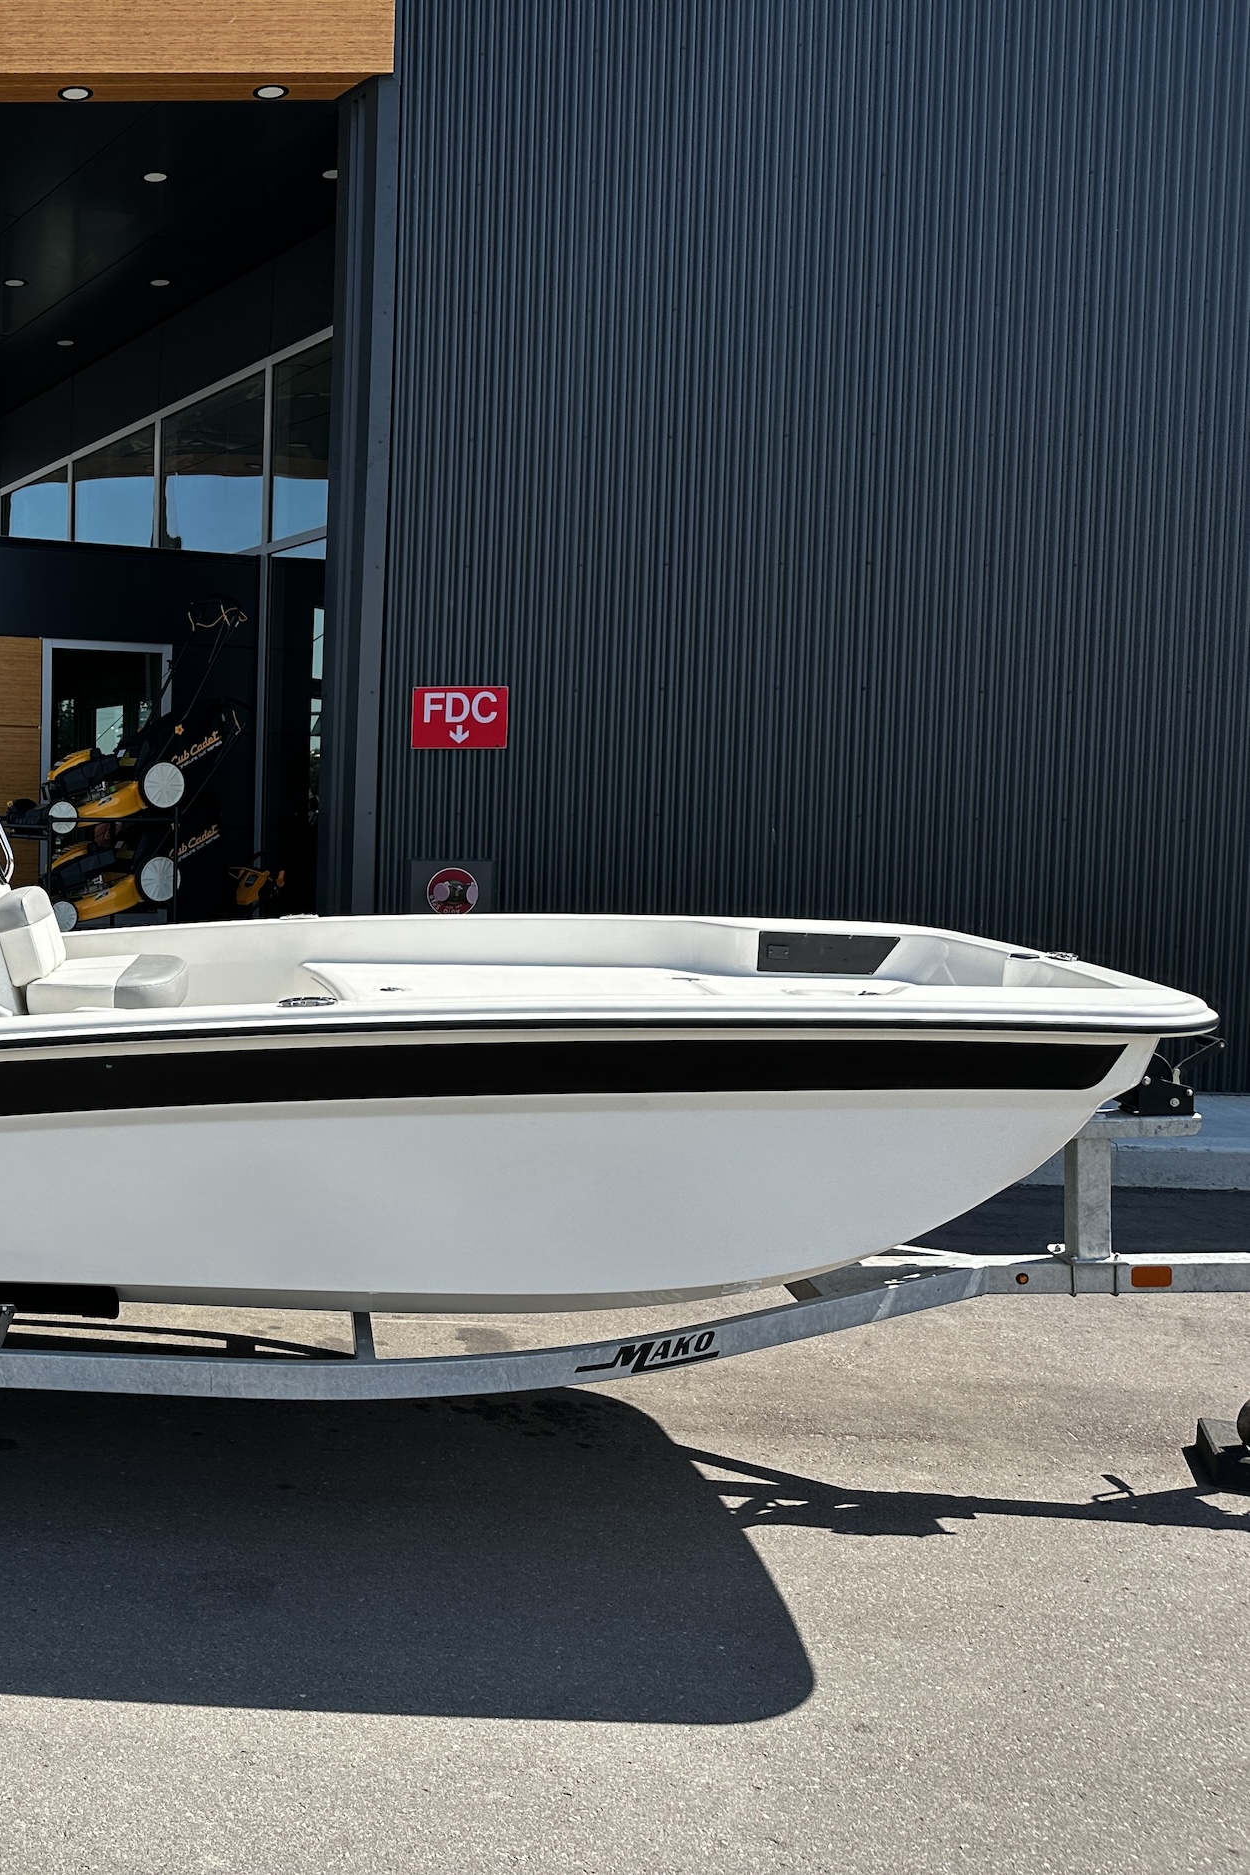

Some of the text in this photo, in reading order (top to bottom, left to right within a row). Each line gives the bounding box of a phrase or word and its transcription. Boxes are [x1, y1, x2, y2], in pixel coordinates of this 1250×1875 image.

[423, 691, 497, 724] FDC
[171, 731, 219, 765] Cub Cadet
[188, 824, 218, 848] Cadet
[574, 1331, 720, 1374] MAKO
